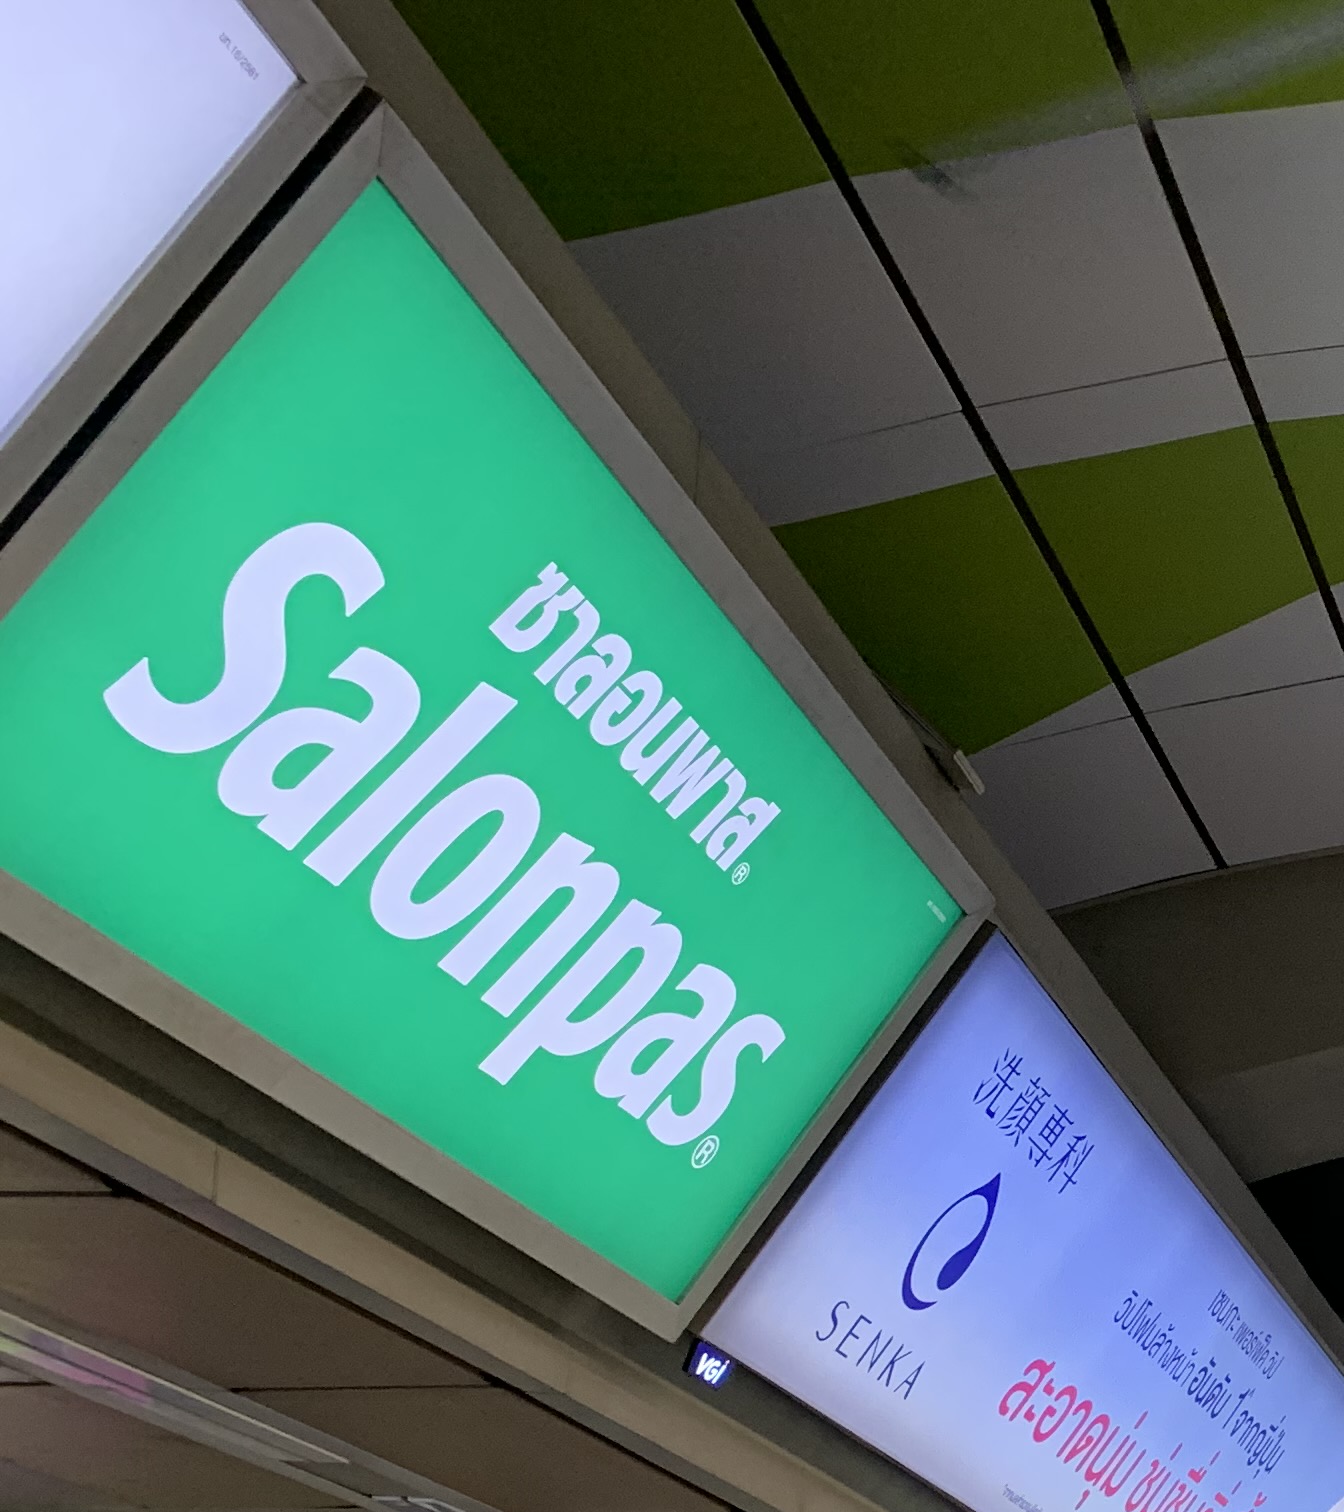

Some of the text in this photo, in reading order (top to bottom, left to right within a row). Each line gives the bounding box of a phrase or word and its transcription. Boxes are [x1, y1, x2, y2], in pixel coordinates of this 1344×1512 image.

[488, 561, 782, 872] ซาลอนพาส
[102, 521, 787, 1148] Salonpas
[815, 1300, 927, 1401] SENKA
[1187, 1356, 1233, 1419] อันดับ
[998, 1358, 1149, 1511] สะอาดนุ่ม
